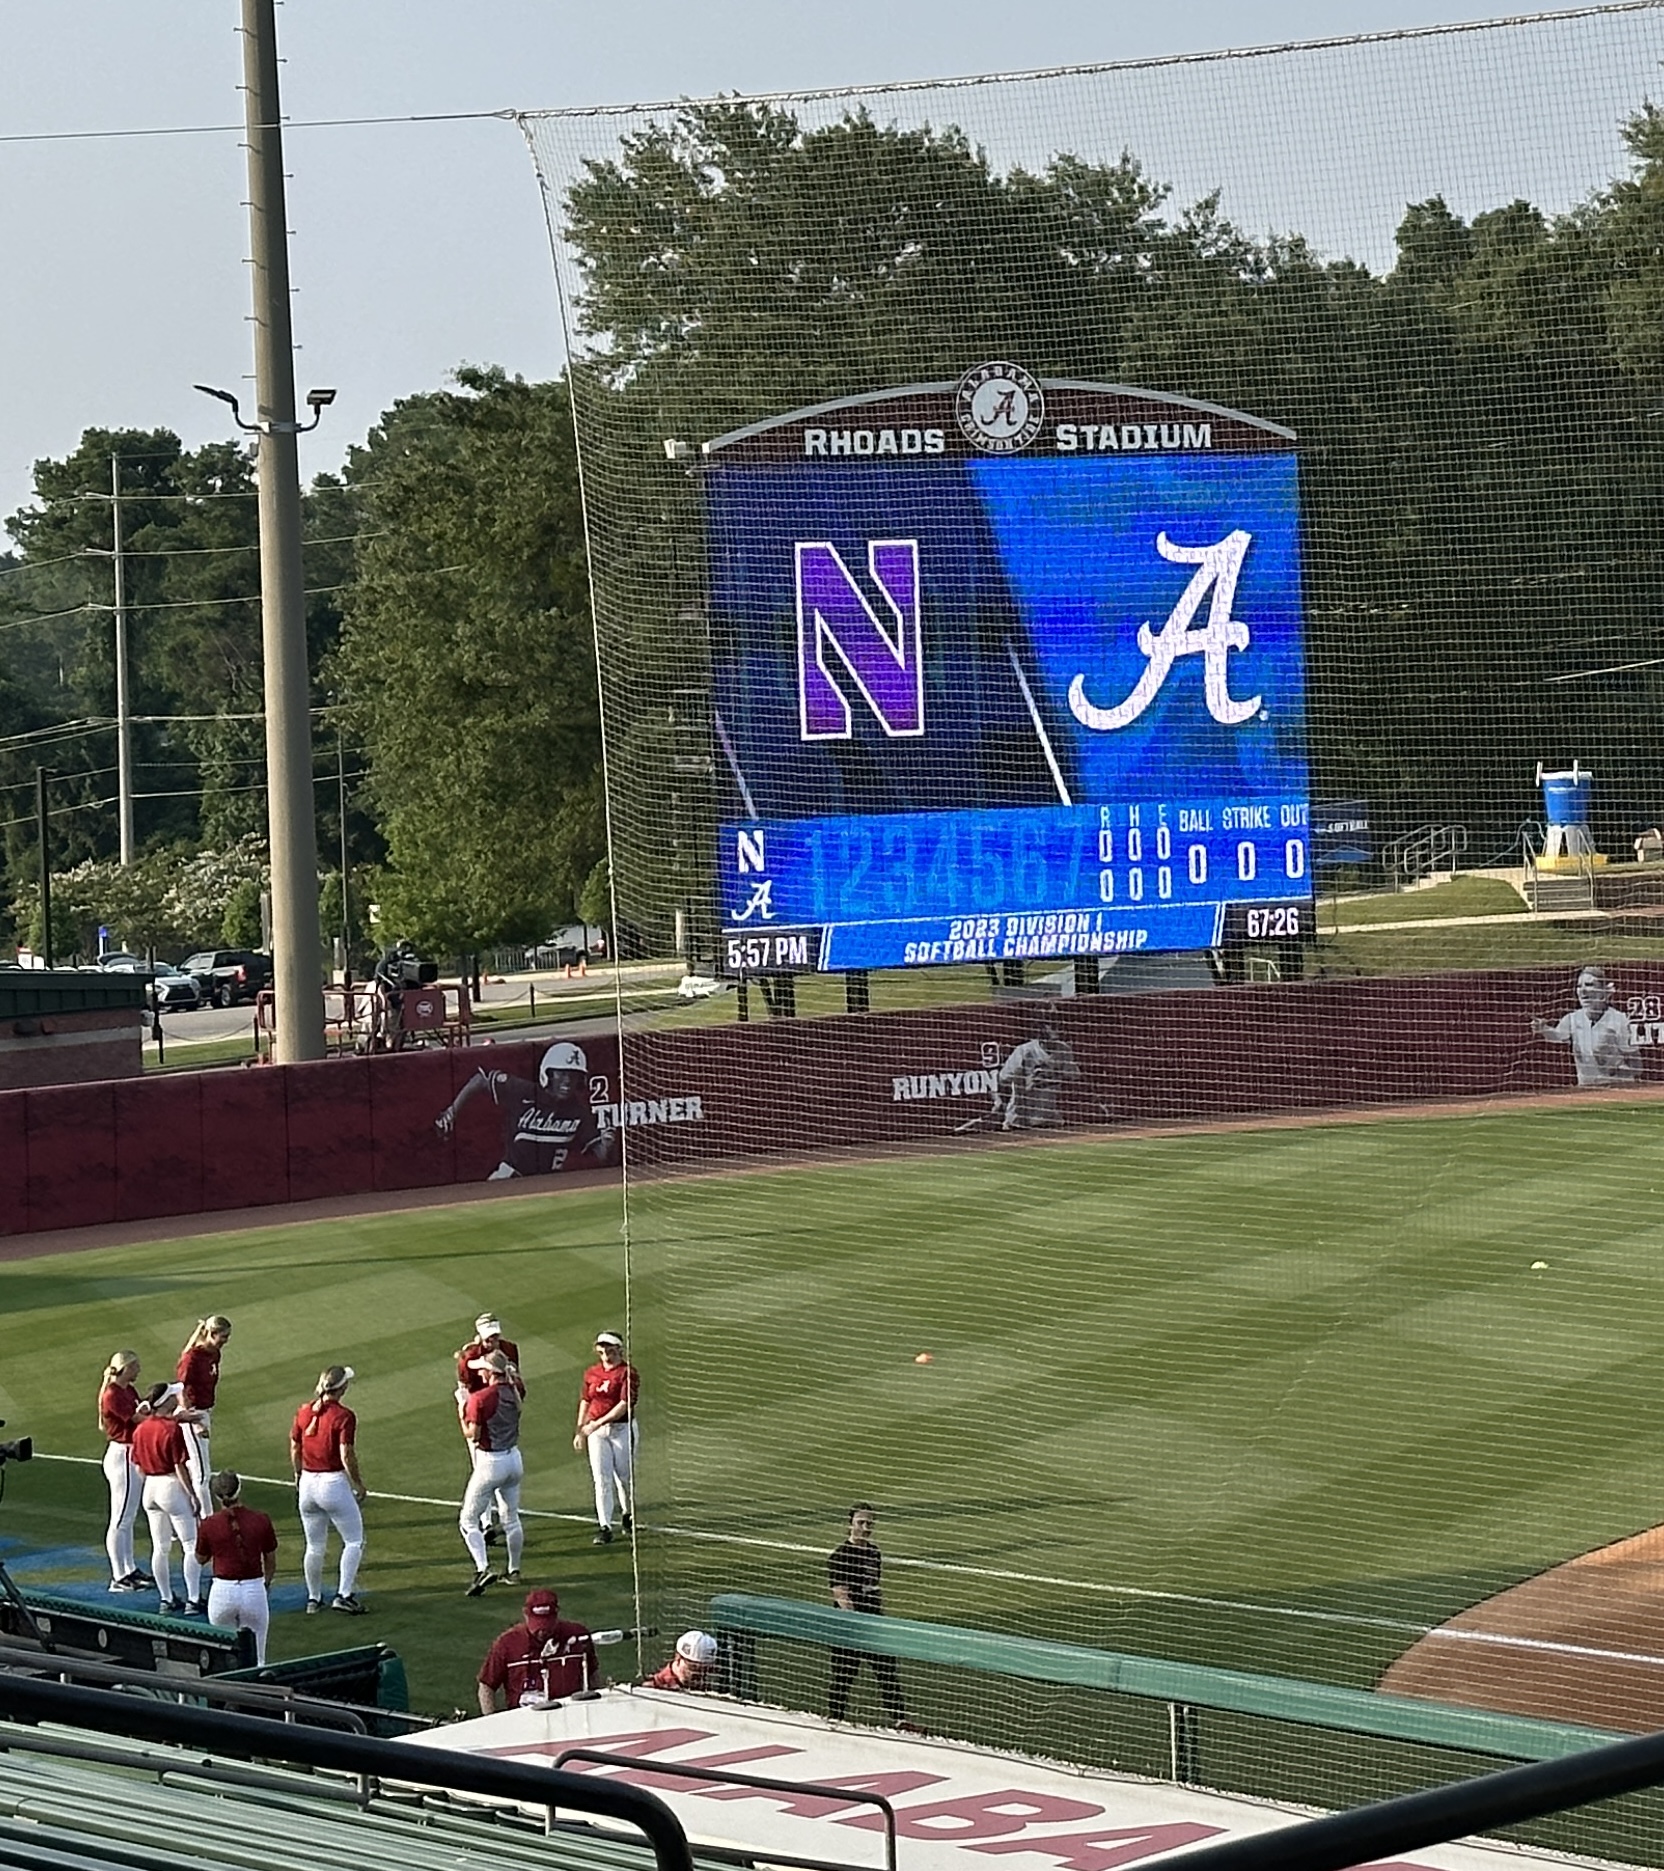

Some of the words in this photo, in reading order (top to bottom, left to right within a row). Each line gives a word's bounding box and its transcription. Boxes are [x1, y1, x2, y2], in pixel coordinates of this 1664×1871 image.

[804, 428, 945, 455] RHOADS
[1056, 423, 1212, 451] STADIUM
[795, 539, 924, 738] N
[1068, 529, 1264, 730] A
[1100, 806, 1111, 829] R
[1129, 805, 1140, 827] H
[1158, 804, 1168, 826] E
[1179, 809, 1213, 832] BALL
[1222, 805, 1271, 830] STRIKE
[1280, 803, 1310, 827] OUT
[737, 830, 765, 873] N
[1100, 829, 1113, 863] 0
[1128, 827, 1142, 862] 0
[1157, 826, 1171, 860] 0
[1188, 844, 1207, 884] 0
[1237, 841, 1256, 881] 0
[1285, 839, 1304, 879] 0
[1100, 869, 1114, 902] 0
[1128, 867, 1143, 901] 0
[1158, 866, 1172, 899] 0
[949, 918, 1000, 940] 2023
[1006, 913, 1090, 937] DIVISION
[1247, 907, 1299, 938] 67:26
[728, 938, 770, 968] 5:57
[775, 936, 807, 966] PM
[903, 937, 997, 963] SOFTBALL
[1003, 929, 1148, 958] CHAMPIONSHIP
[1628, 996, 1661, 1023] 28
[589, 1076, 610, 1104] 2
[892, 1069, 999, 1101] RUNYON
[592, 1096, 704, 1130] TURNER
